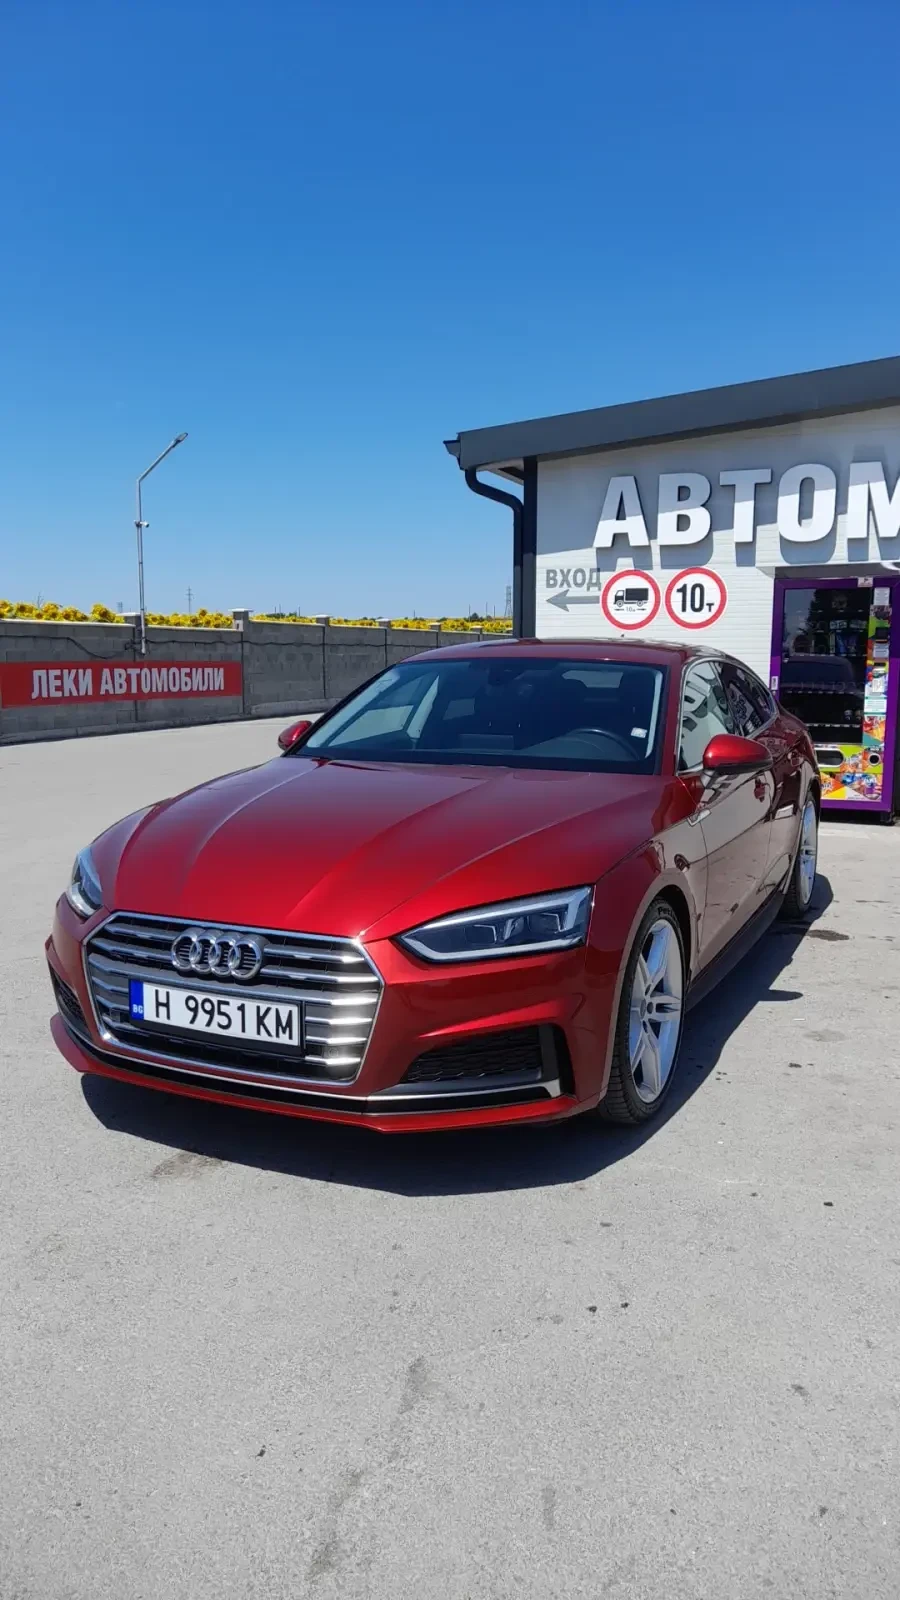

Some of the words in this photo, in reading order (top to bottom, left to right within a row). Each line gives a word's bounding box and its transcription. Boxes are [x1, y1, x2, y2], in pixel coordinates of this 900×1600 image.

[546, 568, 602, 592] ВХОД
[31, 668, 93, 699] ЛЕКИ
[100, 666, 225, 695] АВТОМОБИЛИ
[132, 1004, 143, 1013] BG
[185, 995, 246, 1033] 9951
